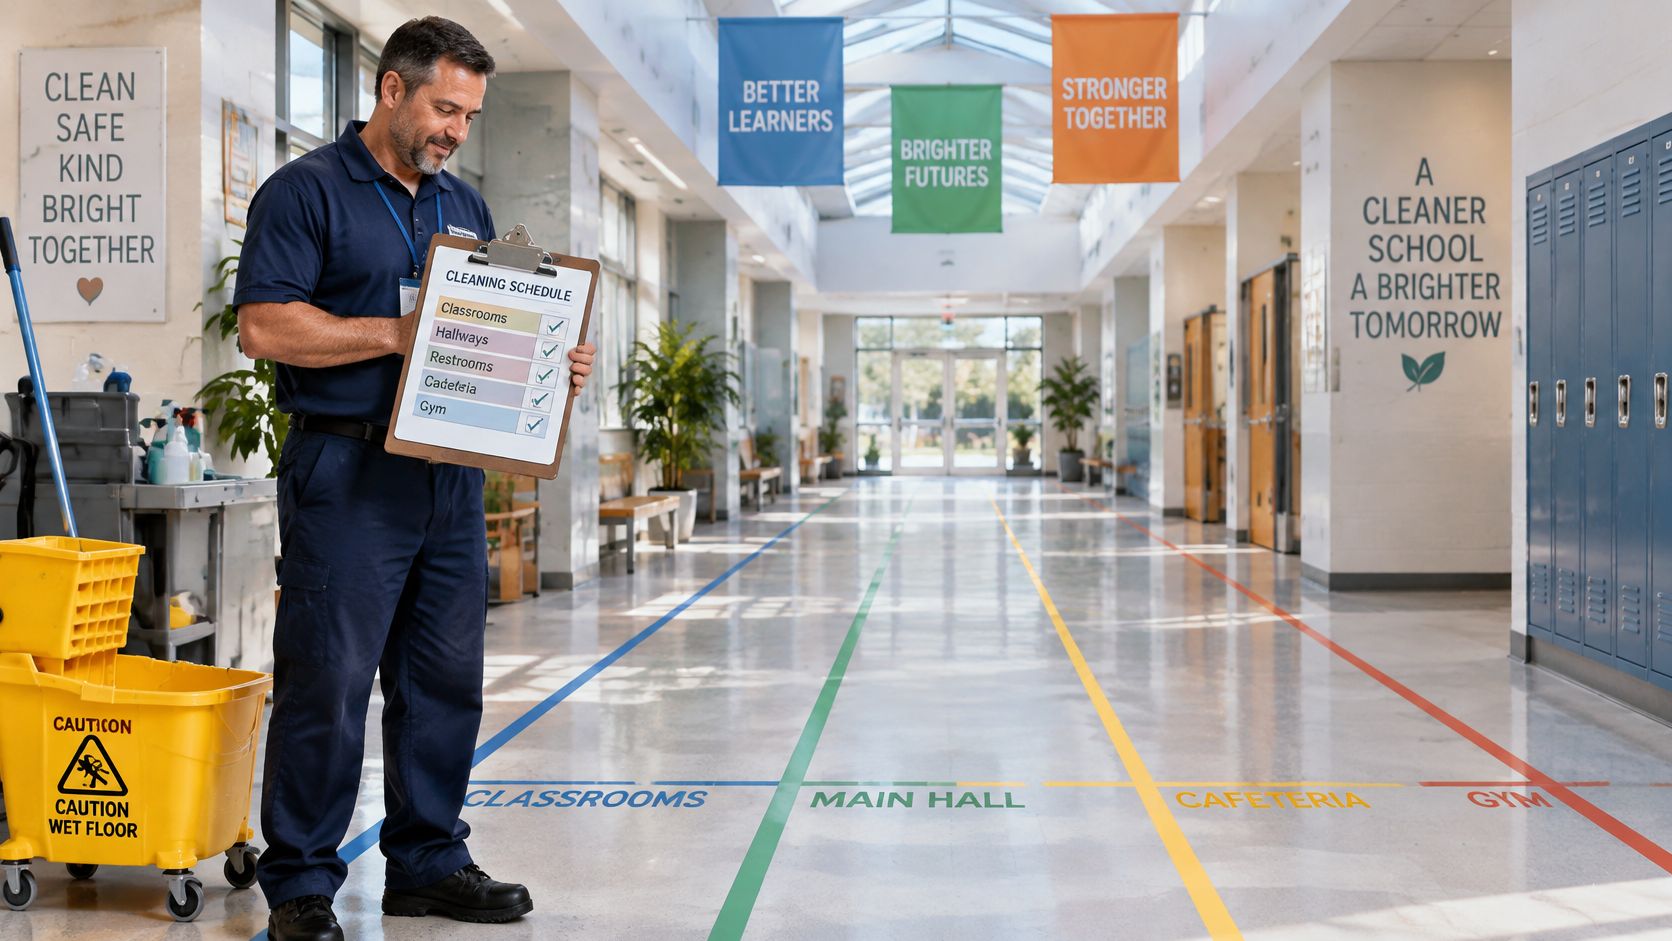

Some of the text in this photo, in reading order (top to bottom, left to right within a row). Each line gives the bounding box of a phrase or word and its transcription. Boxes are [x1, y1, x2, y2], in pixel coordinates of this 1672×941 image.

[45, 72, 134, 101] CLEAN
[743, 80, 819, 104] BETTER
[1062, 77, 1167, 101] STRONGER
[57, 113, 124, 142] SAFE
[728, 109, 833, 133] LEARNERS
[1063, 107, 1167, 130] TOGETHER
[900, 139, 992, 161] BRIGHTER
[60, 154, 122, 182] KIND
[905, 166, 989, 188] FUTURES
[1416, 158, 1433, 185] A
[43, 194, 141, 222] BRIGHT
[1363, 197, 1485, 224] CLEANER
[29, 236, 154, 264] TOGETHER
[1369, 234, 1483, 262] SCHOOL
[446, 270, 572, 301] CLEANING SCHEDULE
[1351, 273, 1500, 300] A BRIGHTER
[442, 303, 507, 323] Classrooms
[1350, 311, 1501, 338] TOMORROW
[436, 326, 489, 345] Hallways
[430, 351, 493, 372] Restrooms
[420, 401, 446, 415] Gym
[56, 799, 128, 818] CAUTION
[463, 790, 708, 808] CLASSROOMS
[810, 792, 1025, 808] MAIN HALL
[1176, 791, 1370, 808] CAFETERIA
[1467, 791, 1553, 808] GYM
[49, 819, 137, 838] WET FLOOR
